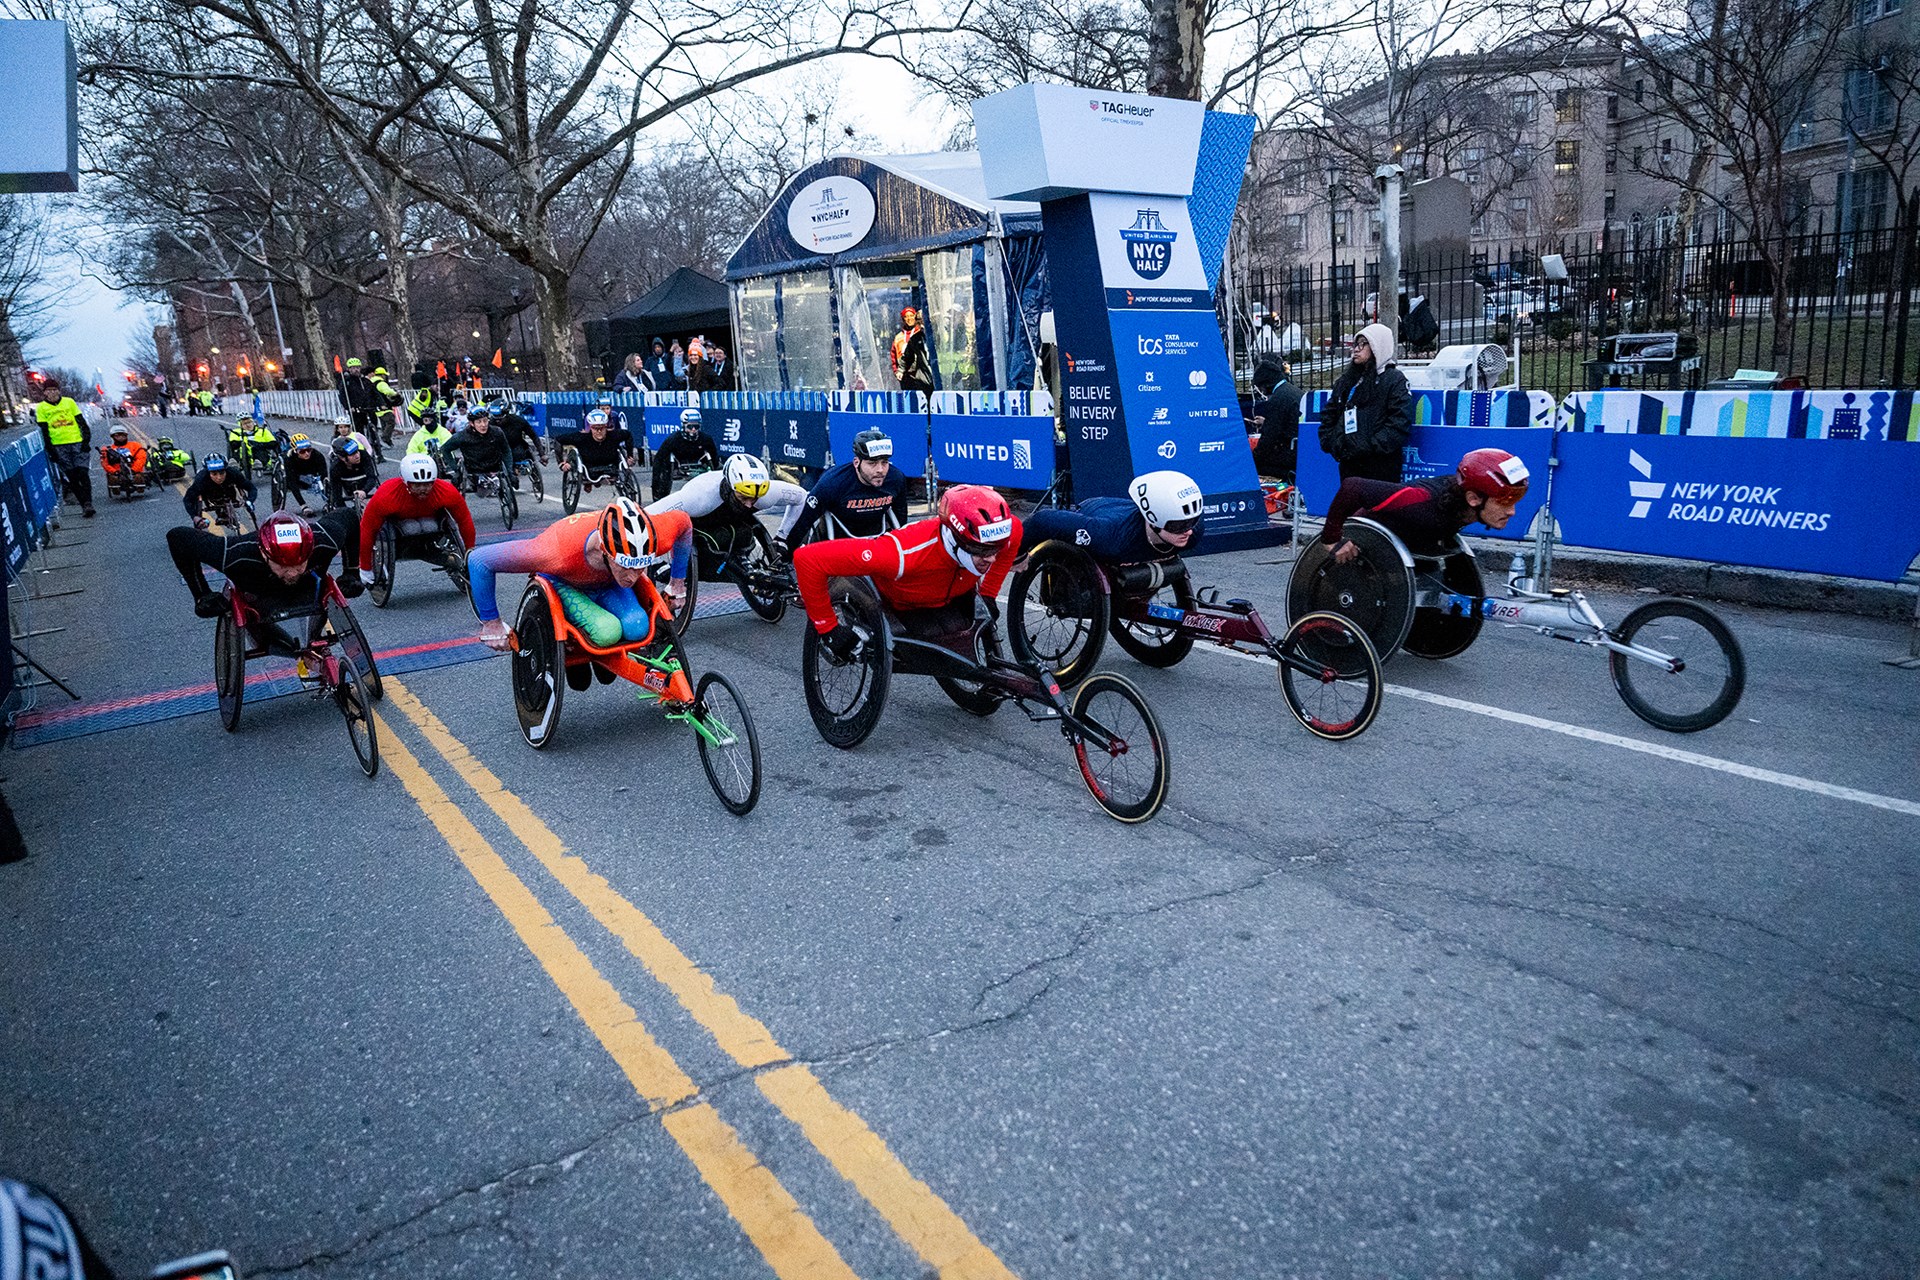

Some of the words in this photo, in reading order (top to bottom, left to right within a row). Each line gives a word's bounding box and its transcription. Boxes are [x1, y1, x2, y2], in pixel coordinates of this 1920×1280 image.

[1133, 243, 1165, 260] NYC
[1136, 260, 1163, 271] HALF
[1138, 334, 1163, 355] tcs
[1069, 386, 1111, 400] BELIEVE
[1138, 384, 1161, 392] Citizens
[1069, 406, 1080, 419] IN
[1082, 406, 1117, 420] EVERY
[1189, 410, 1219, 418] UNITED
[1081, 426, 1109, 440] STEP
[783, 443, 806, 459] Citizens
[945, 442, 1009, 461] UNITED
[1199, 441, 1225, 452] ESPN
[1671, 482, 1720, 500] NEW
[1722, 484, 1782, 505] YORK
[846, 495, 894, 509] ILLINOIS
[949, 514, 966, 533] CLIF
[1667, 502, 1724, 523] ROAD
[1726, 507, 1831, 532] RUNNERS
[619, 555, 653, 567] SCHIPPER
